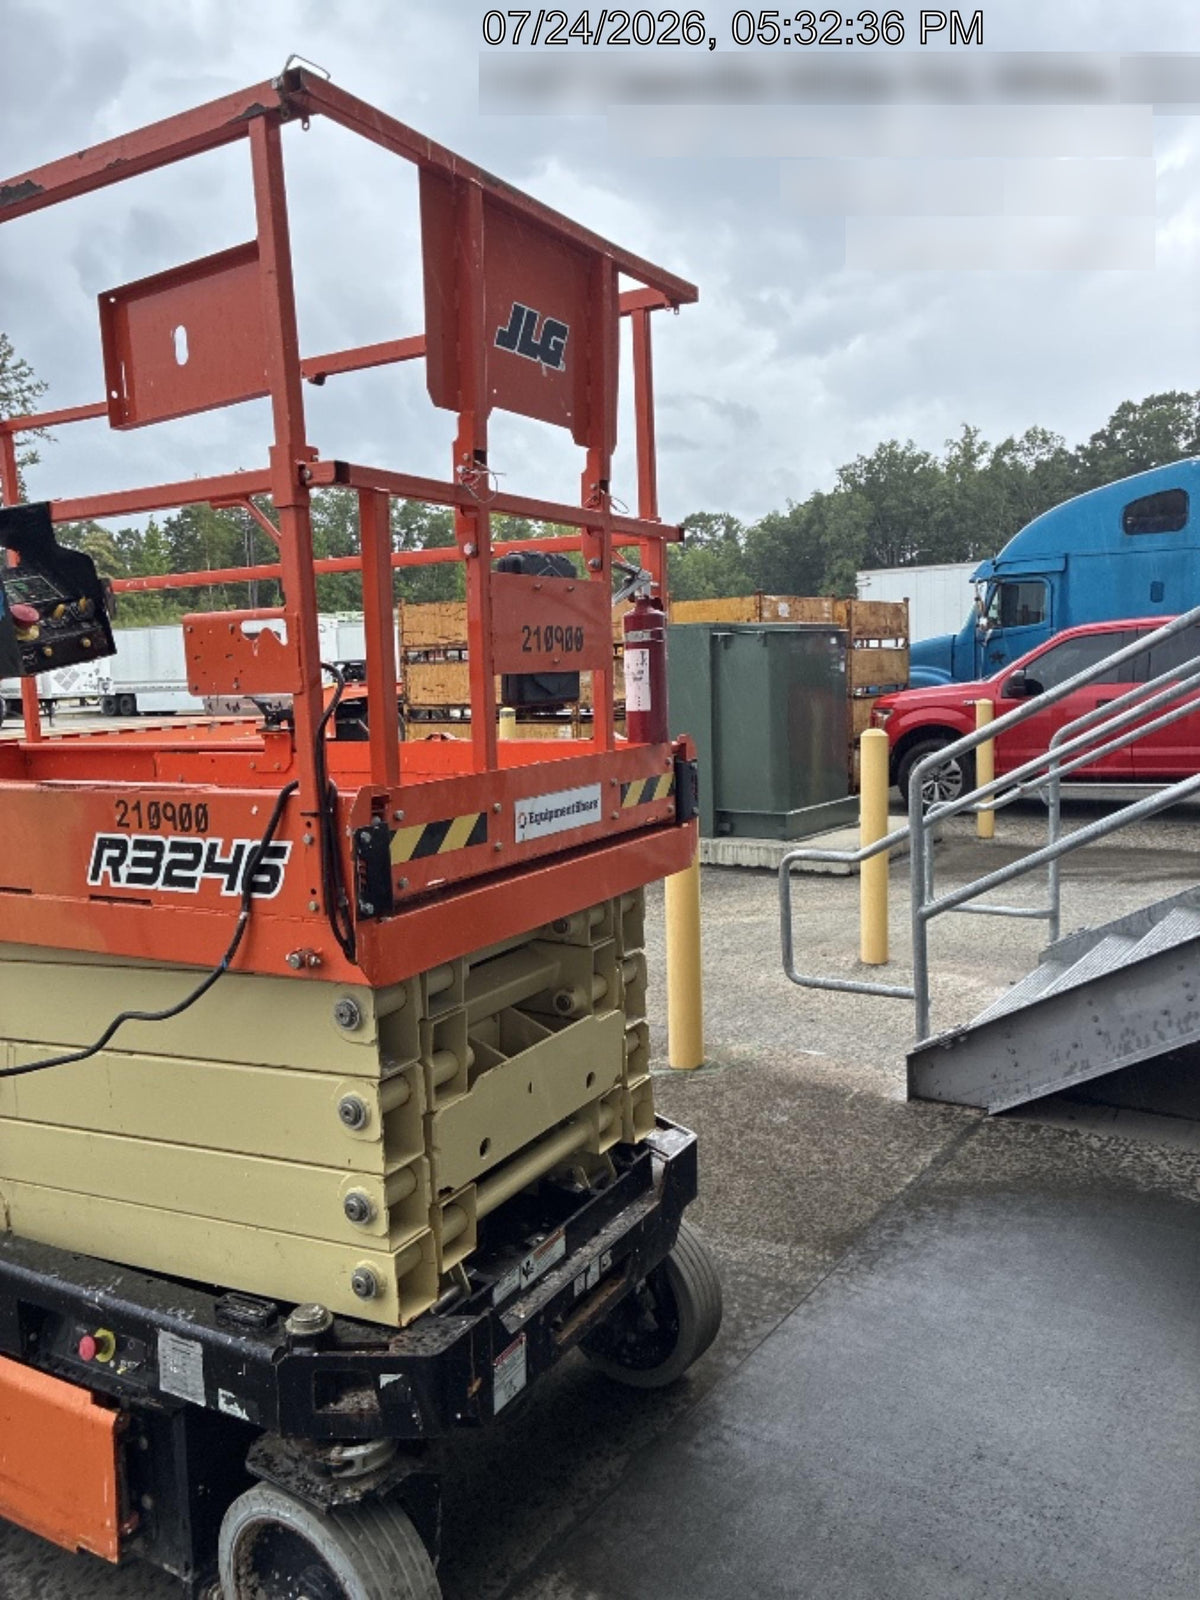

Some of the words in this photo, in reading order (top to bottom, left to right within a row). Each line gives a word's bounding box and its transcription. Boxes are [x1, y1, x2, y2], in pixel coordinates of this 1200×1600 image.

[494, 301, 570, 371] JLG
[521, 625, 584, 653] 210900
[115, 799, 208, 833] 210900
[87, 833, 293, 899] R3246
